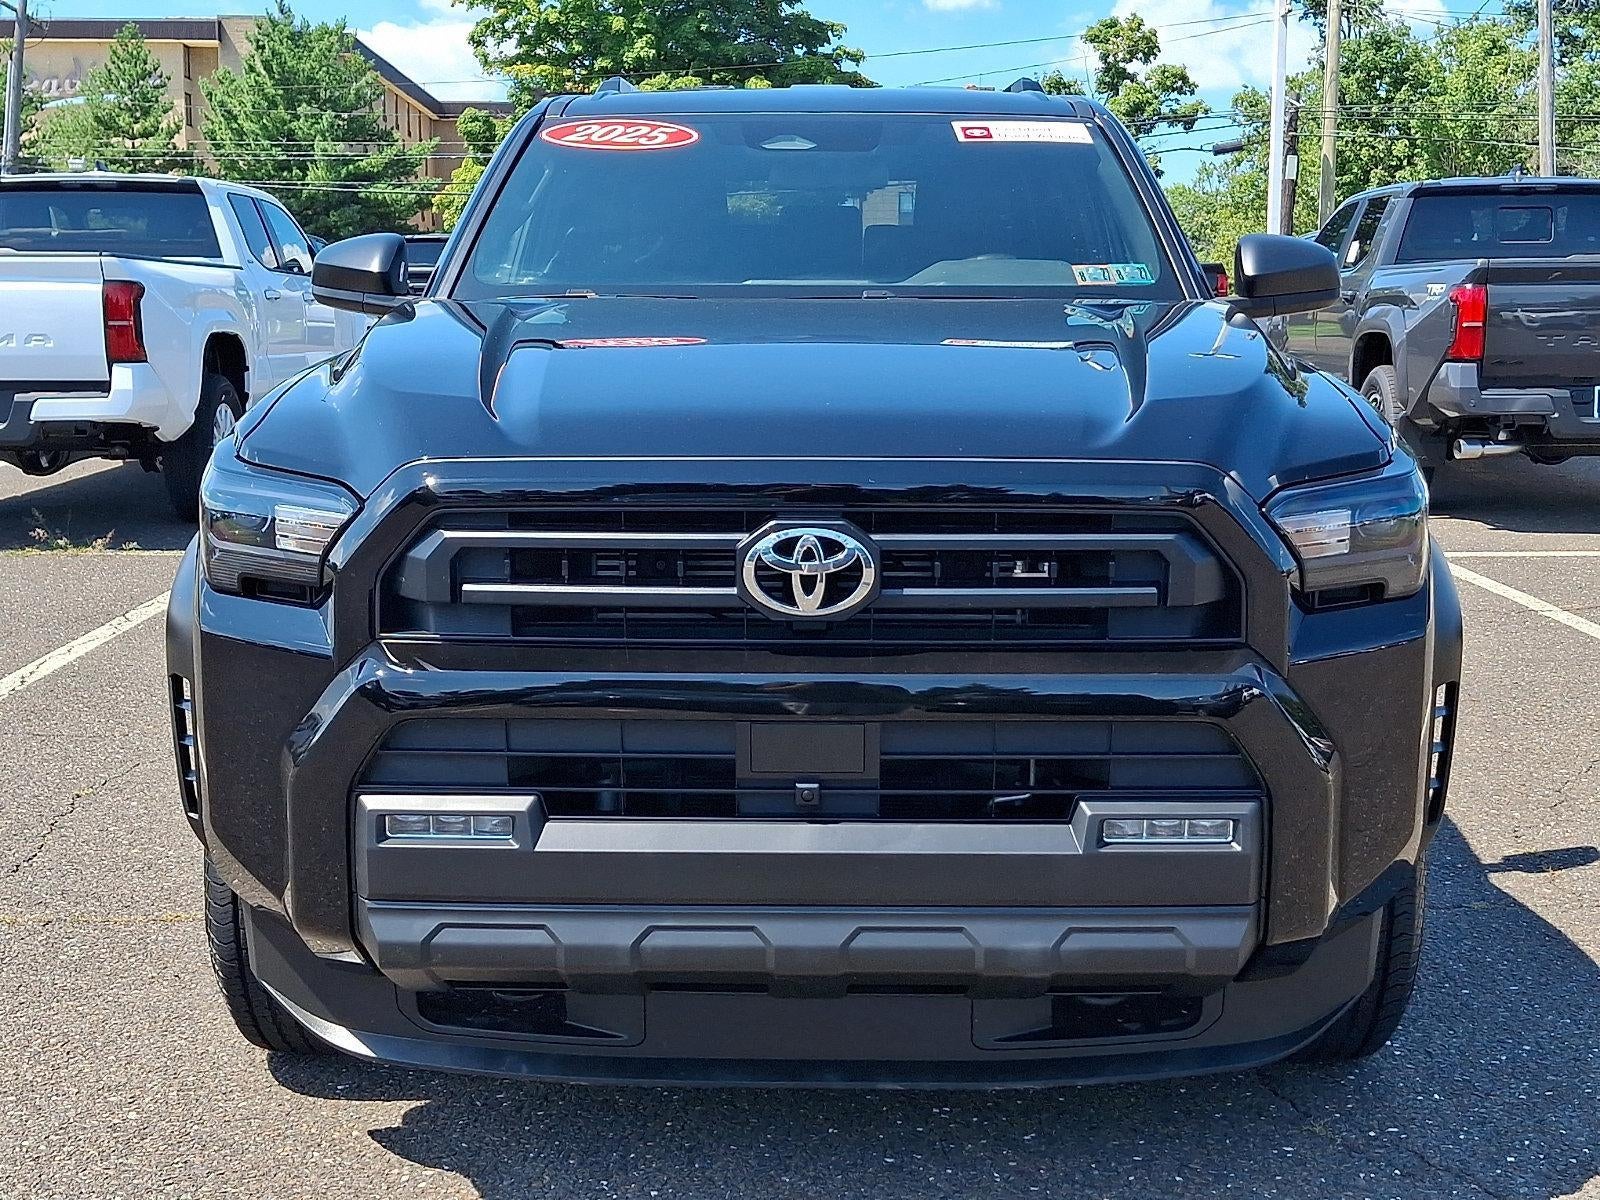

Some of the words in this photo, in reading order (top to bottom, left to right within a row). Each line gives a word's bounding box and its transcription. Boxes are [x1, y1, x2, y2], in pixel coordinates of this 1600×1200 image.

[561, 124, 678, 145] 2025
[1078, 271, 1087, 282] 8
[1116, 269, 1125, 281] 8
